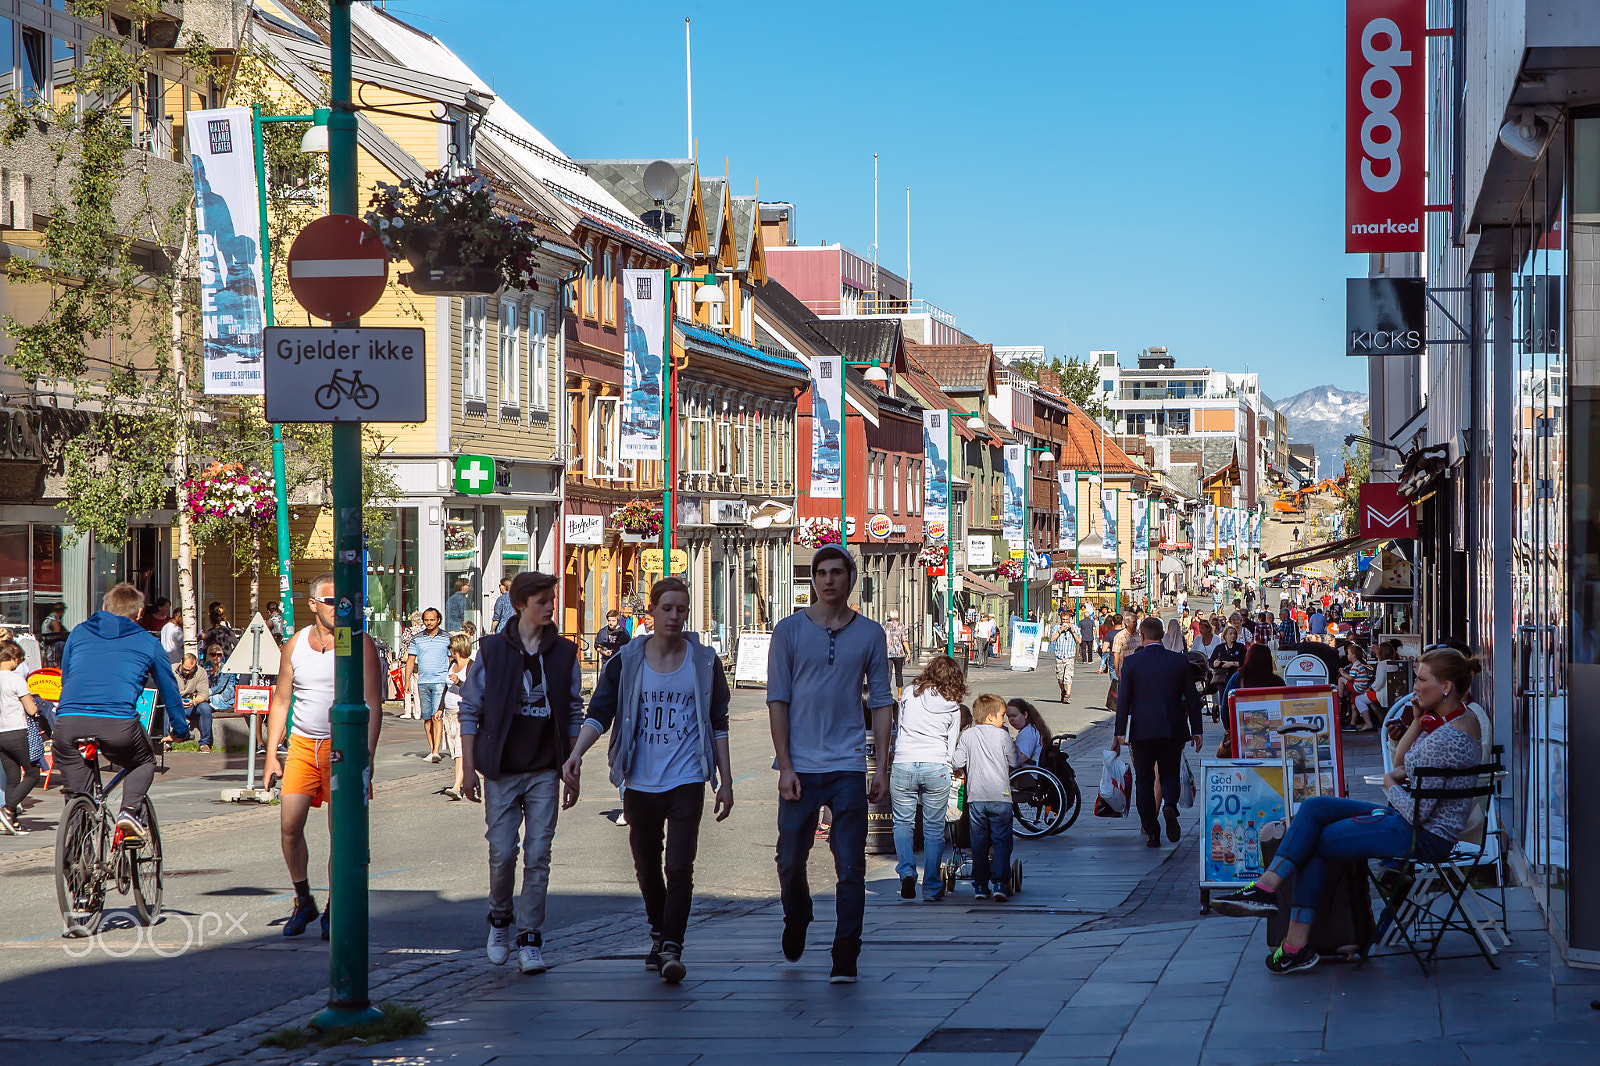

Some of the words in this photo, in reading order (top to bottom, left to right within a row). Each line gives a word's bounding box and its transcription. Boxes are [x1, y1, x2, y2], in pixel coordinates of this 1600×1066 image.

[1361, 17, 1412, 193] coop
[1351, 218, 1419, 235] marked
[1353, 330, 1420, 349] KICKS
[276, 339, 361, 365] Gjelder
[368, 339, 414, 360] ikke
[872, 523, 890, 533] KING
[928, 526, 945, 535] KING
[639, 690, 693, 706] UTHENTIC
[1210, 774, 1232, 784] God
[1210, 784, 1252, 793] sommer
